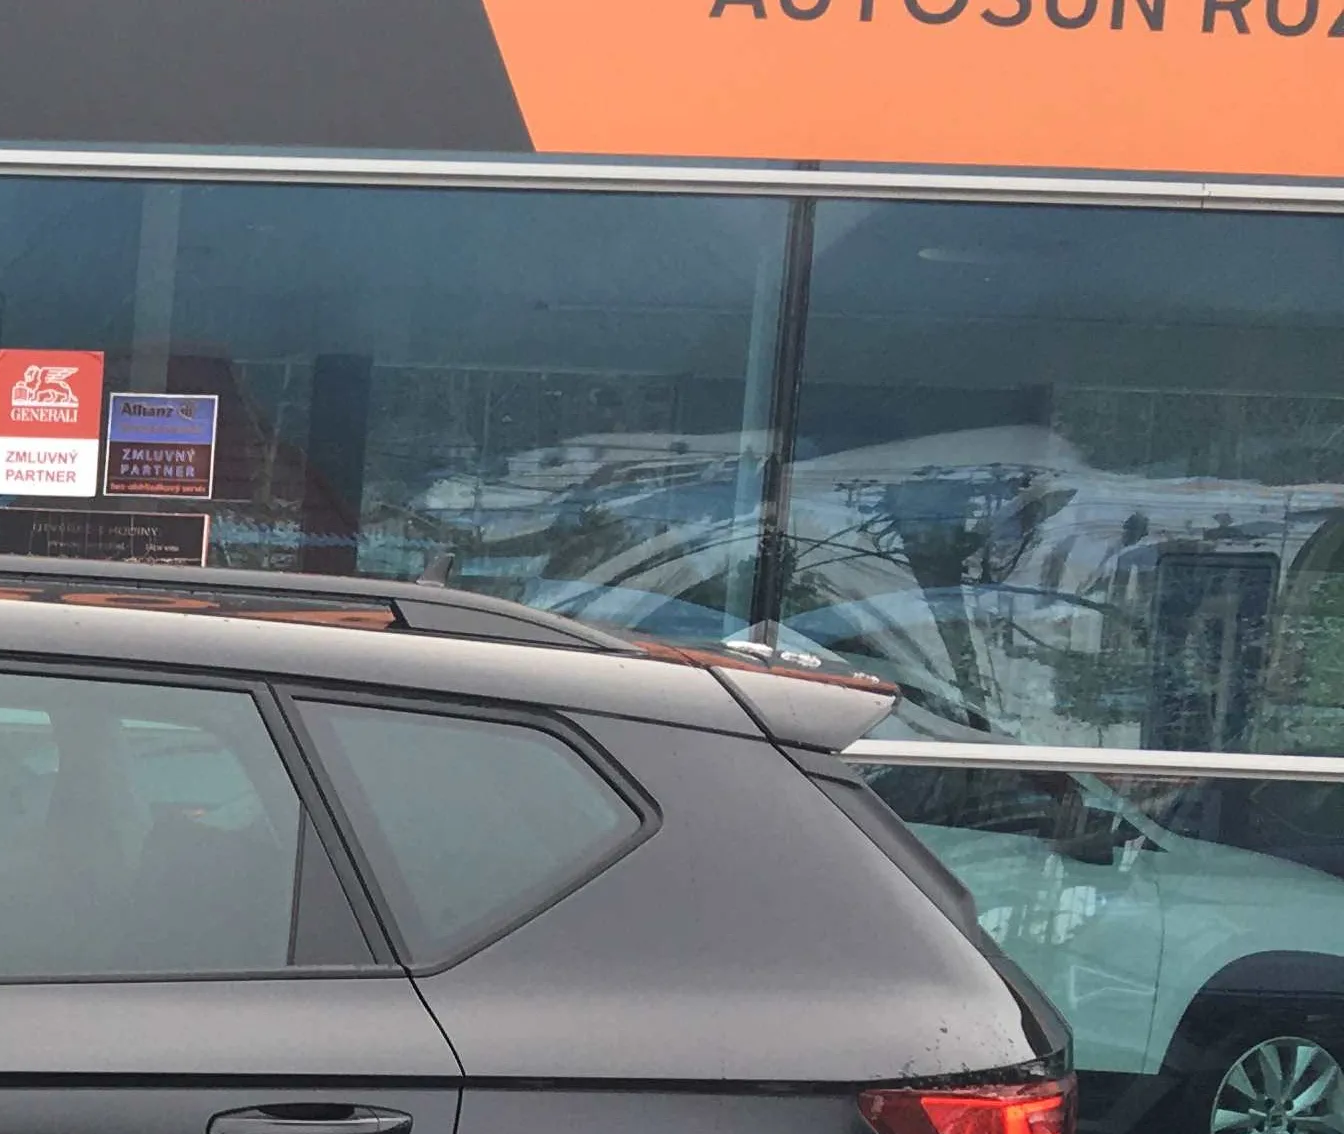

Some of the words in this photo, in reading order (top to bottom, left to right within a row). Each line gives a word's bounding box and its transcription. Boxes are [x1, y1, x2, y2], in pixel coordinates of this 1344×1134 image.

[1201, 0, 1344, 37] RU
[10, 407, 79, 423] GENERALI
[121, 402, 174, 418] Allianz
[5, 449, 78, 464] ZMLUVNÝ
[122, 447, 195, 462] ZMLUVNÝ
[5, 469, 76, 483] PARTNER
[120, 464, 195, 477] PARTNER
